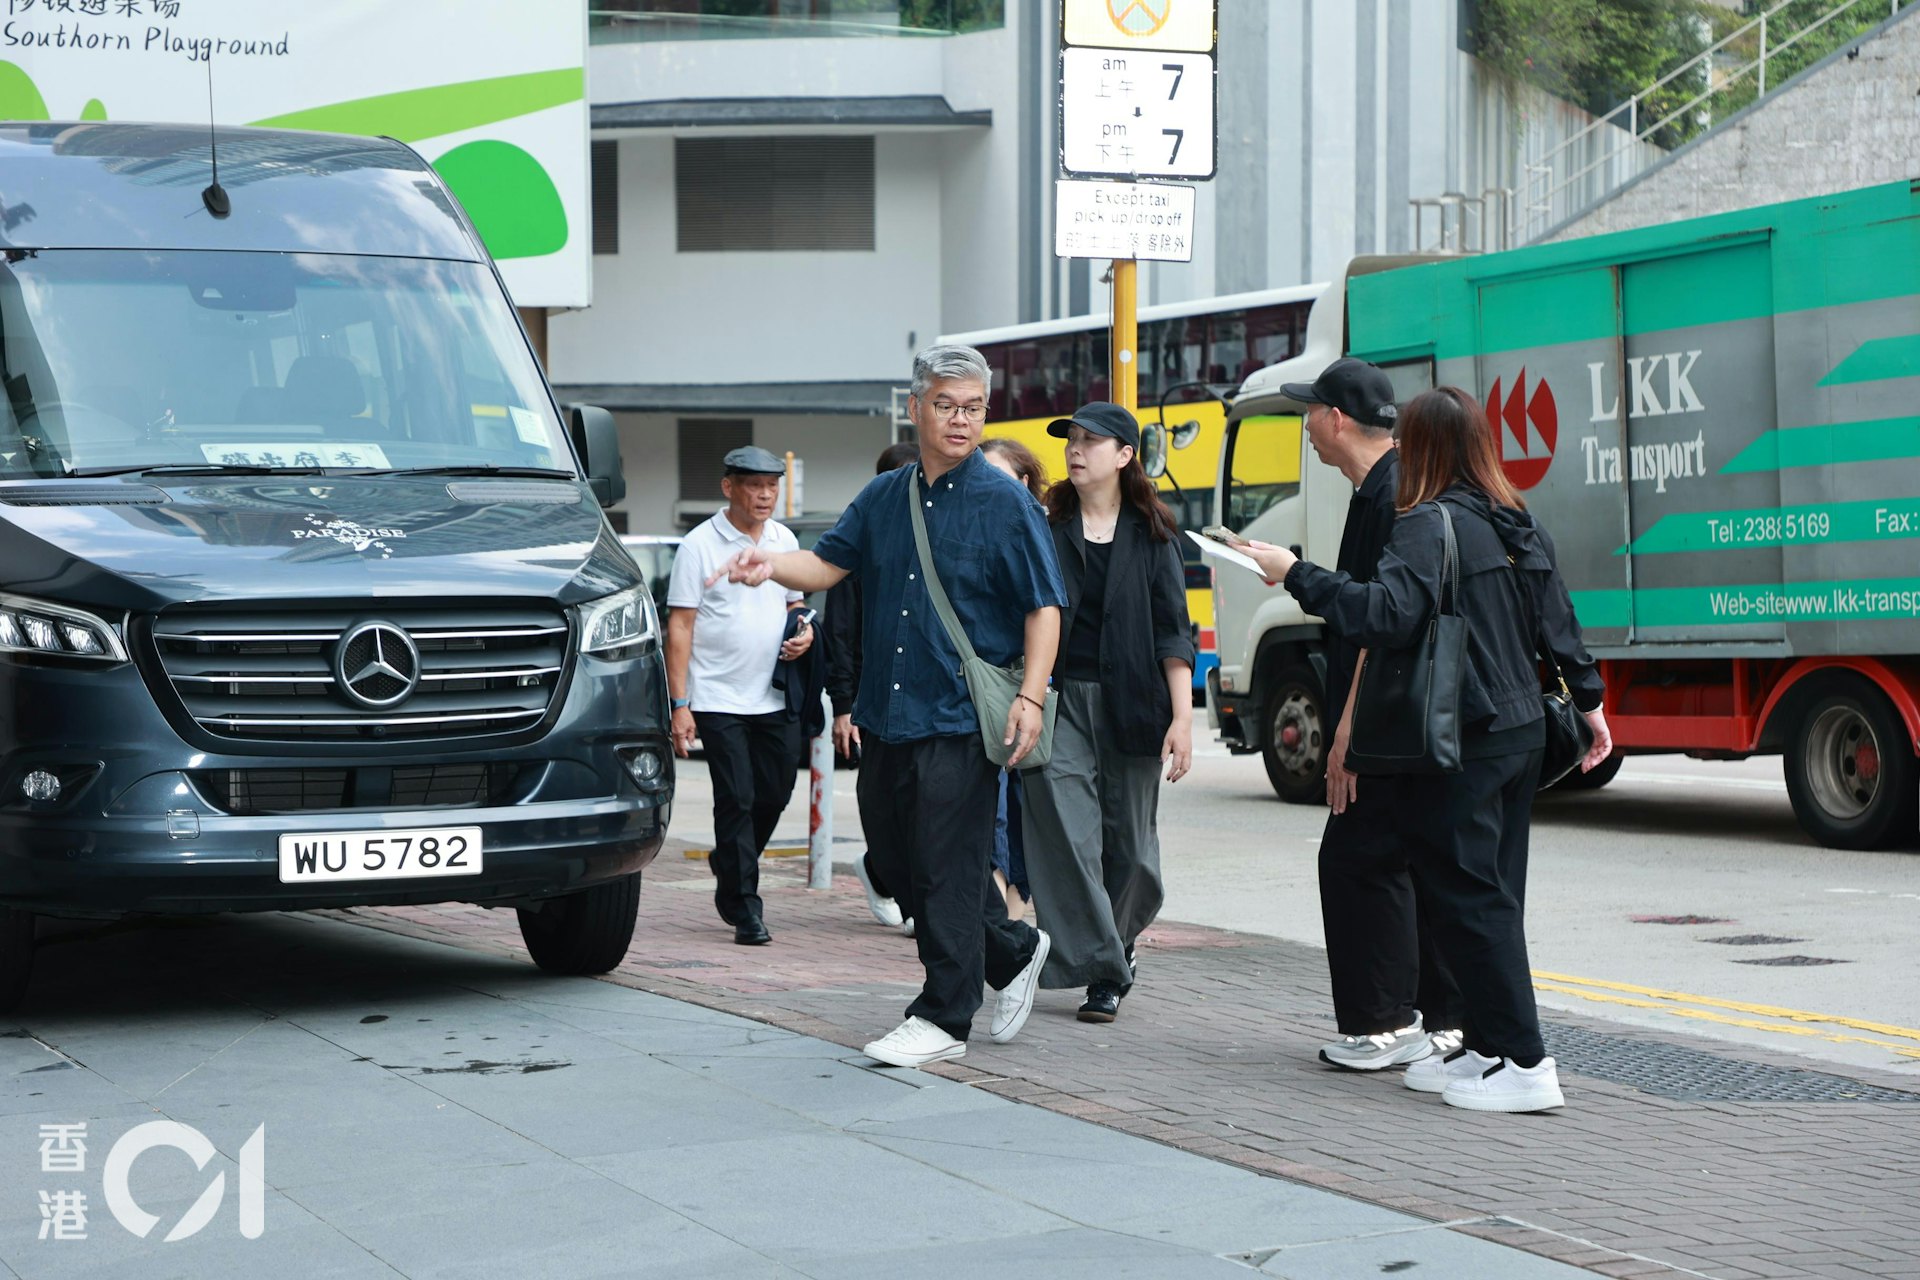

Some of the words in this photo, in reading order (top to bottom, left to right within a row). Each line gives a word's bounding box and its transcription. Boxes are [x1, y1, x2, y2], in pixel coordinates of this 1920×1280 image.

[4, 21, 130, 50] Southorn
[144, 26, 289, 62] Playground
[1102, 58, 1127, 71] am
[1095, 78, 1135, 98] 上午
[1162, 63, 1184, 101] 7
[1102, 123, 1127, 139] pm
[1095, 144, 1135, 164] 下午
[1162, 128, 1184, 165] 7
[1095, 189, 1144, 207] Except
[1149, 192, 1171, 207] taxi
[1074, 210, 1105, 224] pick
[1166, 212, 1182, 226] off
[1581, 429, 1706, 494] Transport
[1875, 508, 1919, 534] Fax:
[291, 528, 407, 539] PARADISE
[294, 841, 347, 874] WU
[363, 835, 468, 871] 5782
